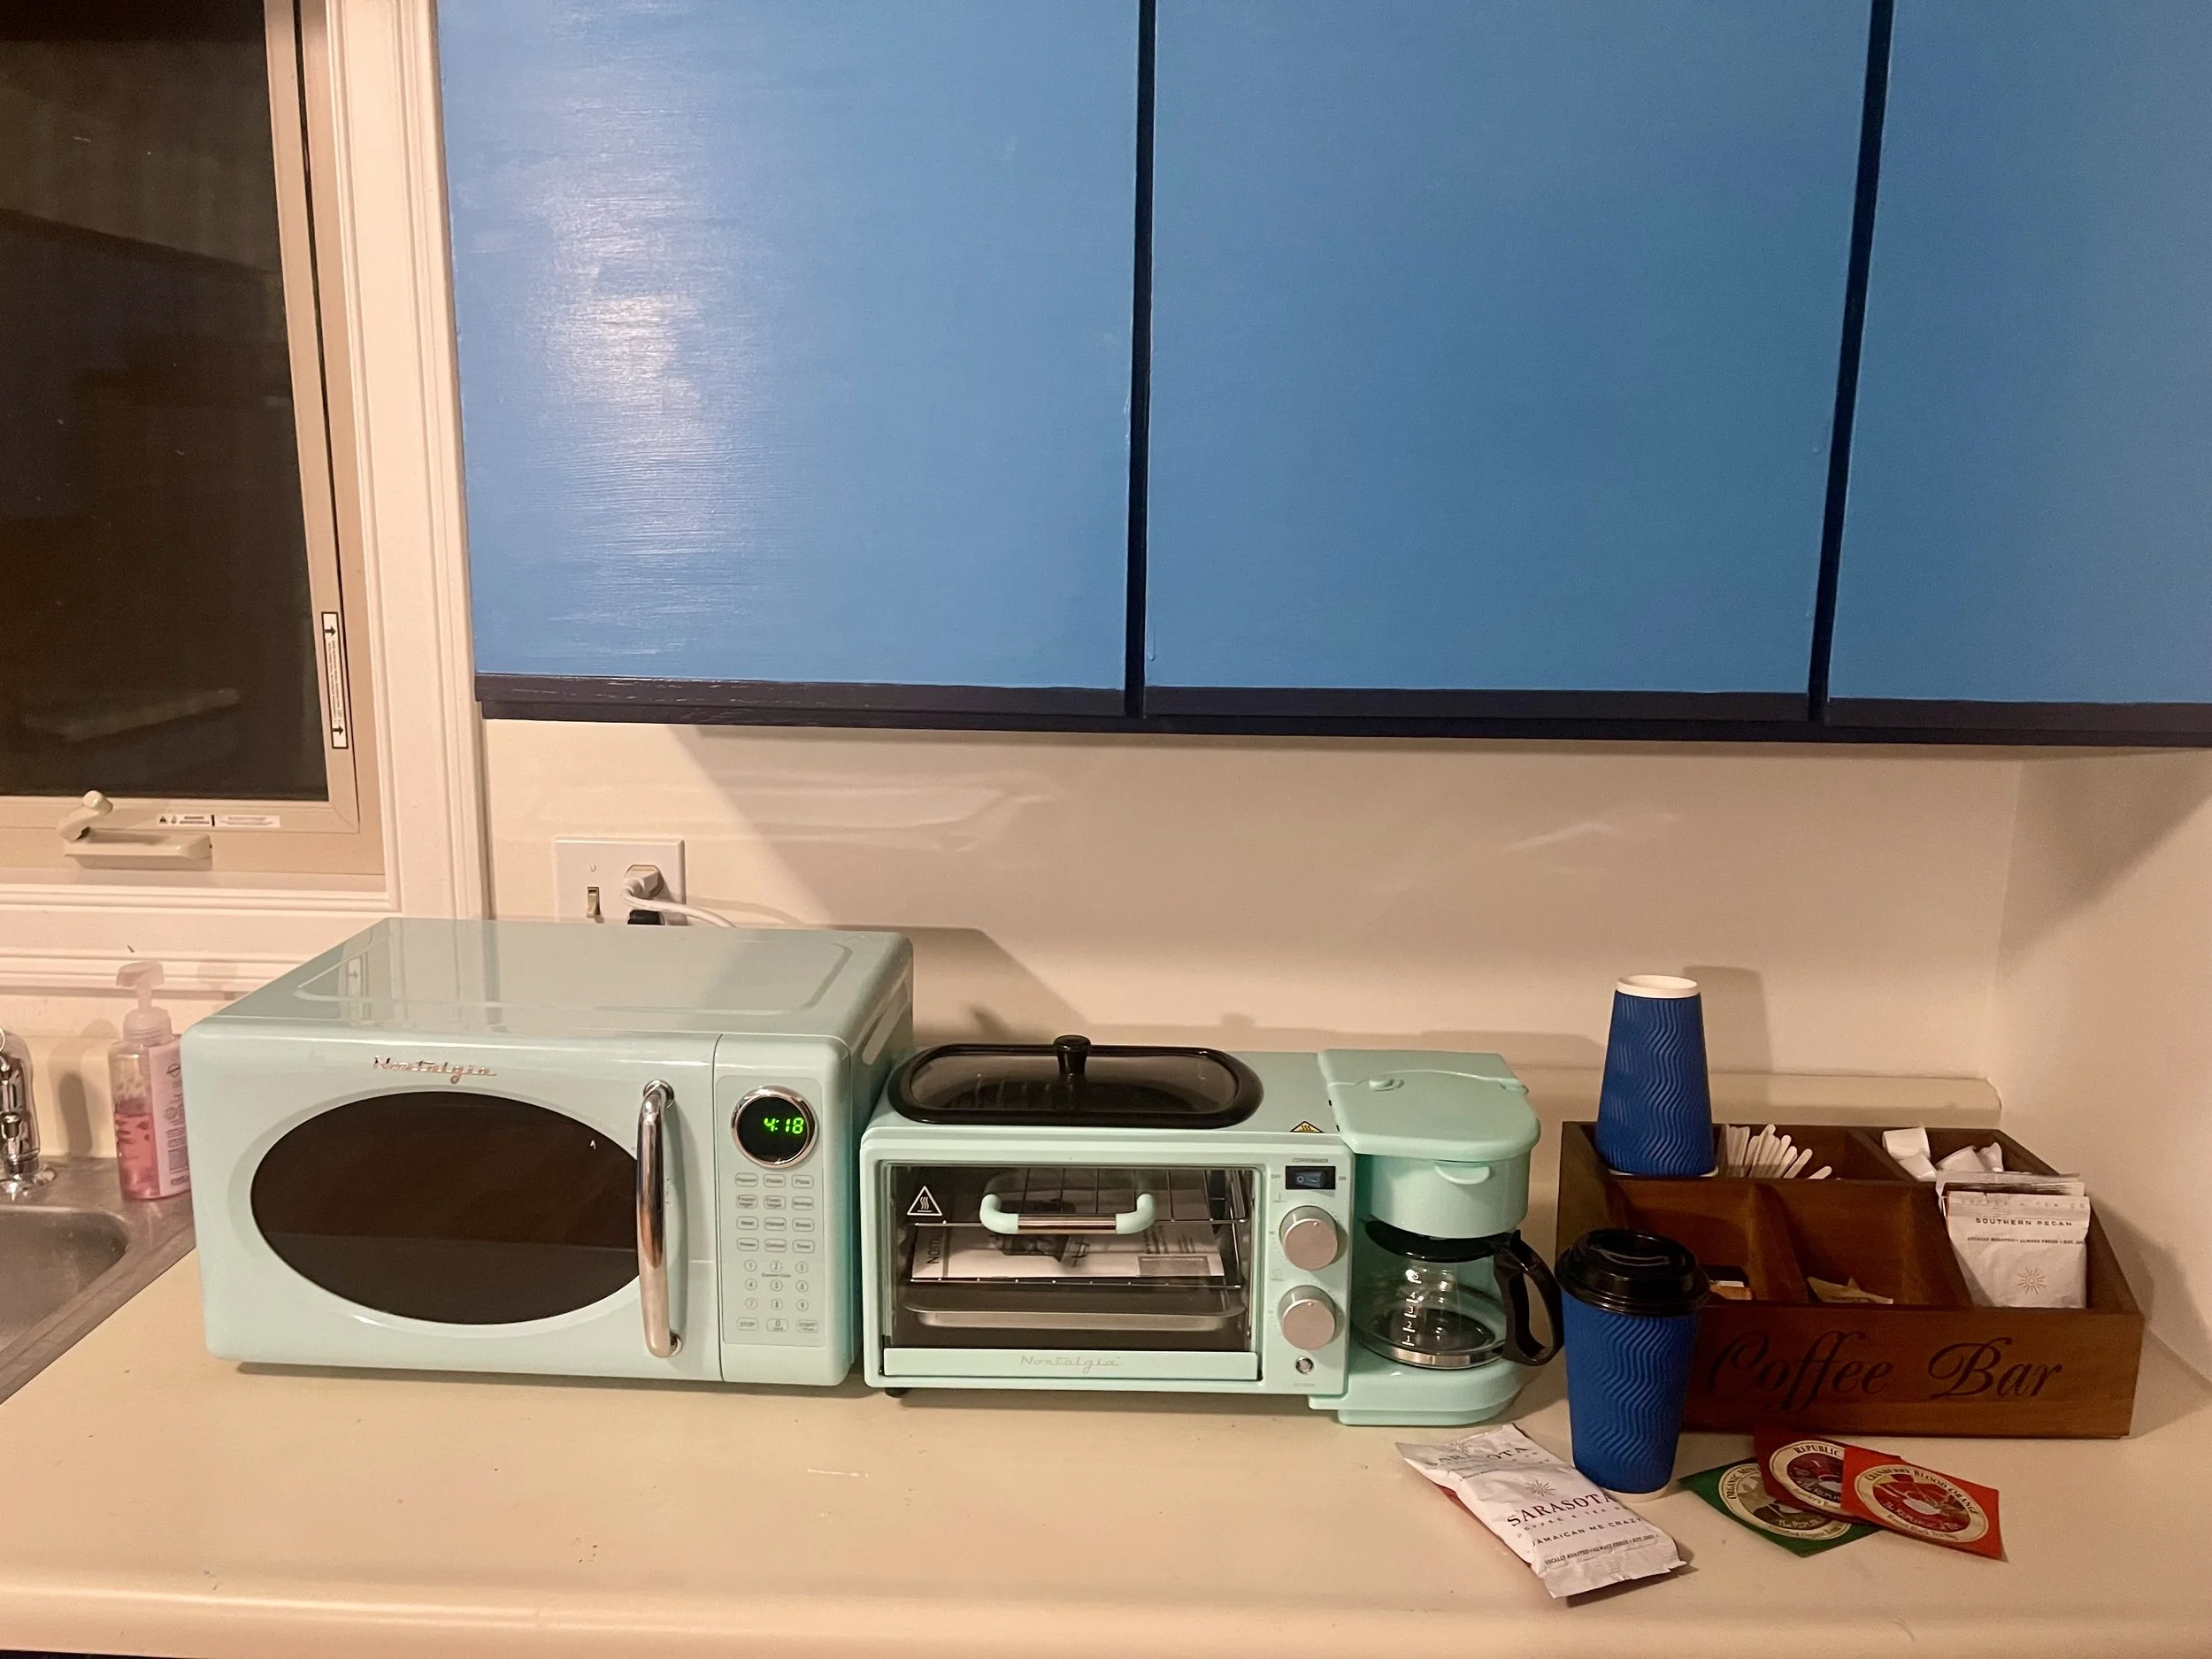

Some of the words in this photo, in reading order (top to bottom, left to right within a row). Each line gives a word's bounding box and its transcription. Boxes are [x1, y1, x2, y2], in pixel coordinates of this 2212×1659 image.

[373, 1056, 497, 1085] Nostalgia
[764, 1118, 804, 1134] 4:18
[1020, 1356, 1121, 1374] Nostalgia
[1708, 1330, 1893, 1413] Coffee
[1927, 1336, 2063, 1399] Bar
[1793, 1444, 1840, 1456] REPUBLIC
[1864, 1468, 1911, 1481] CRANBERRY
[1913, 1470, 1947, 1488] BLOOD
[1532, 1528, 1586, 1548] JAMAICAN
